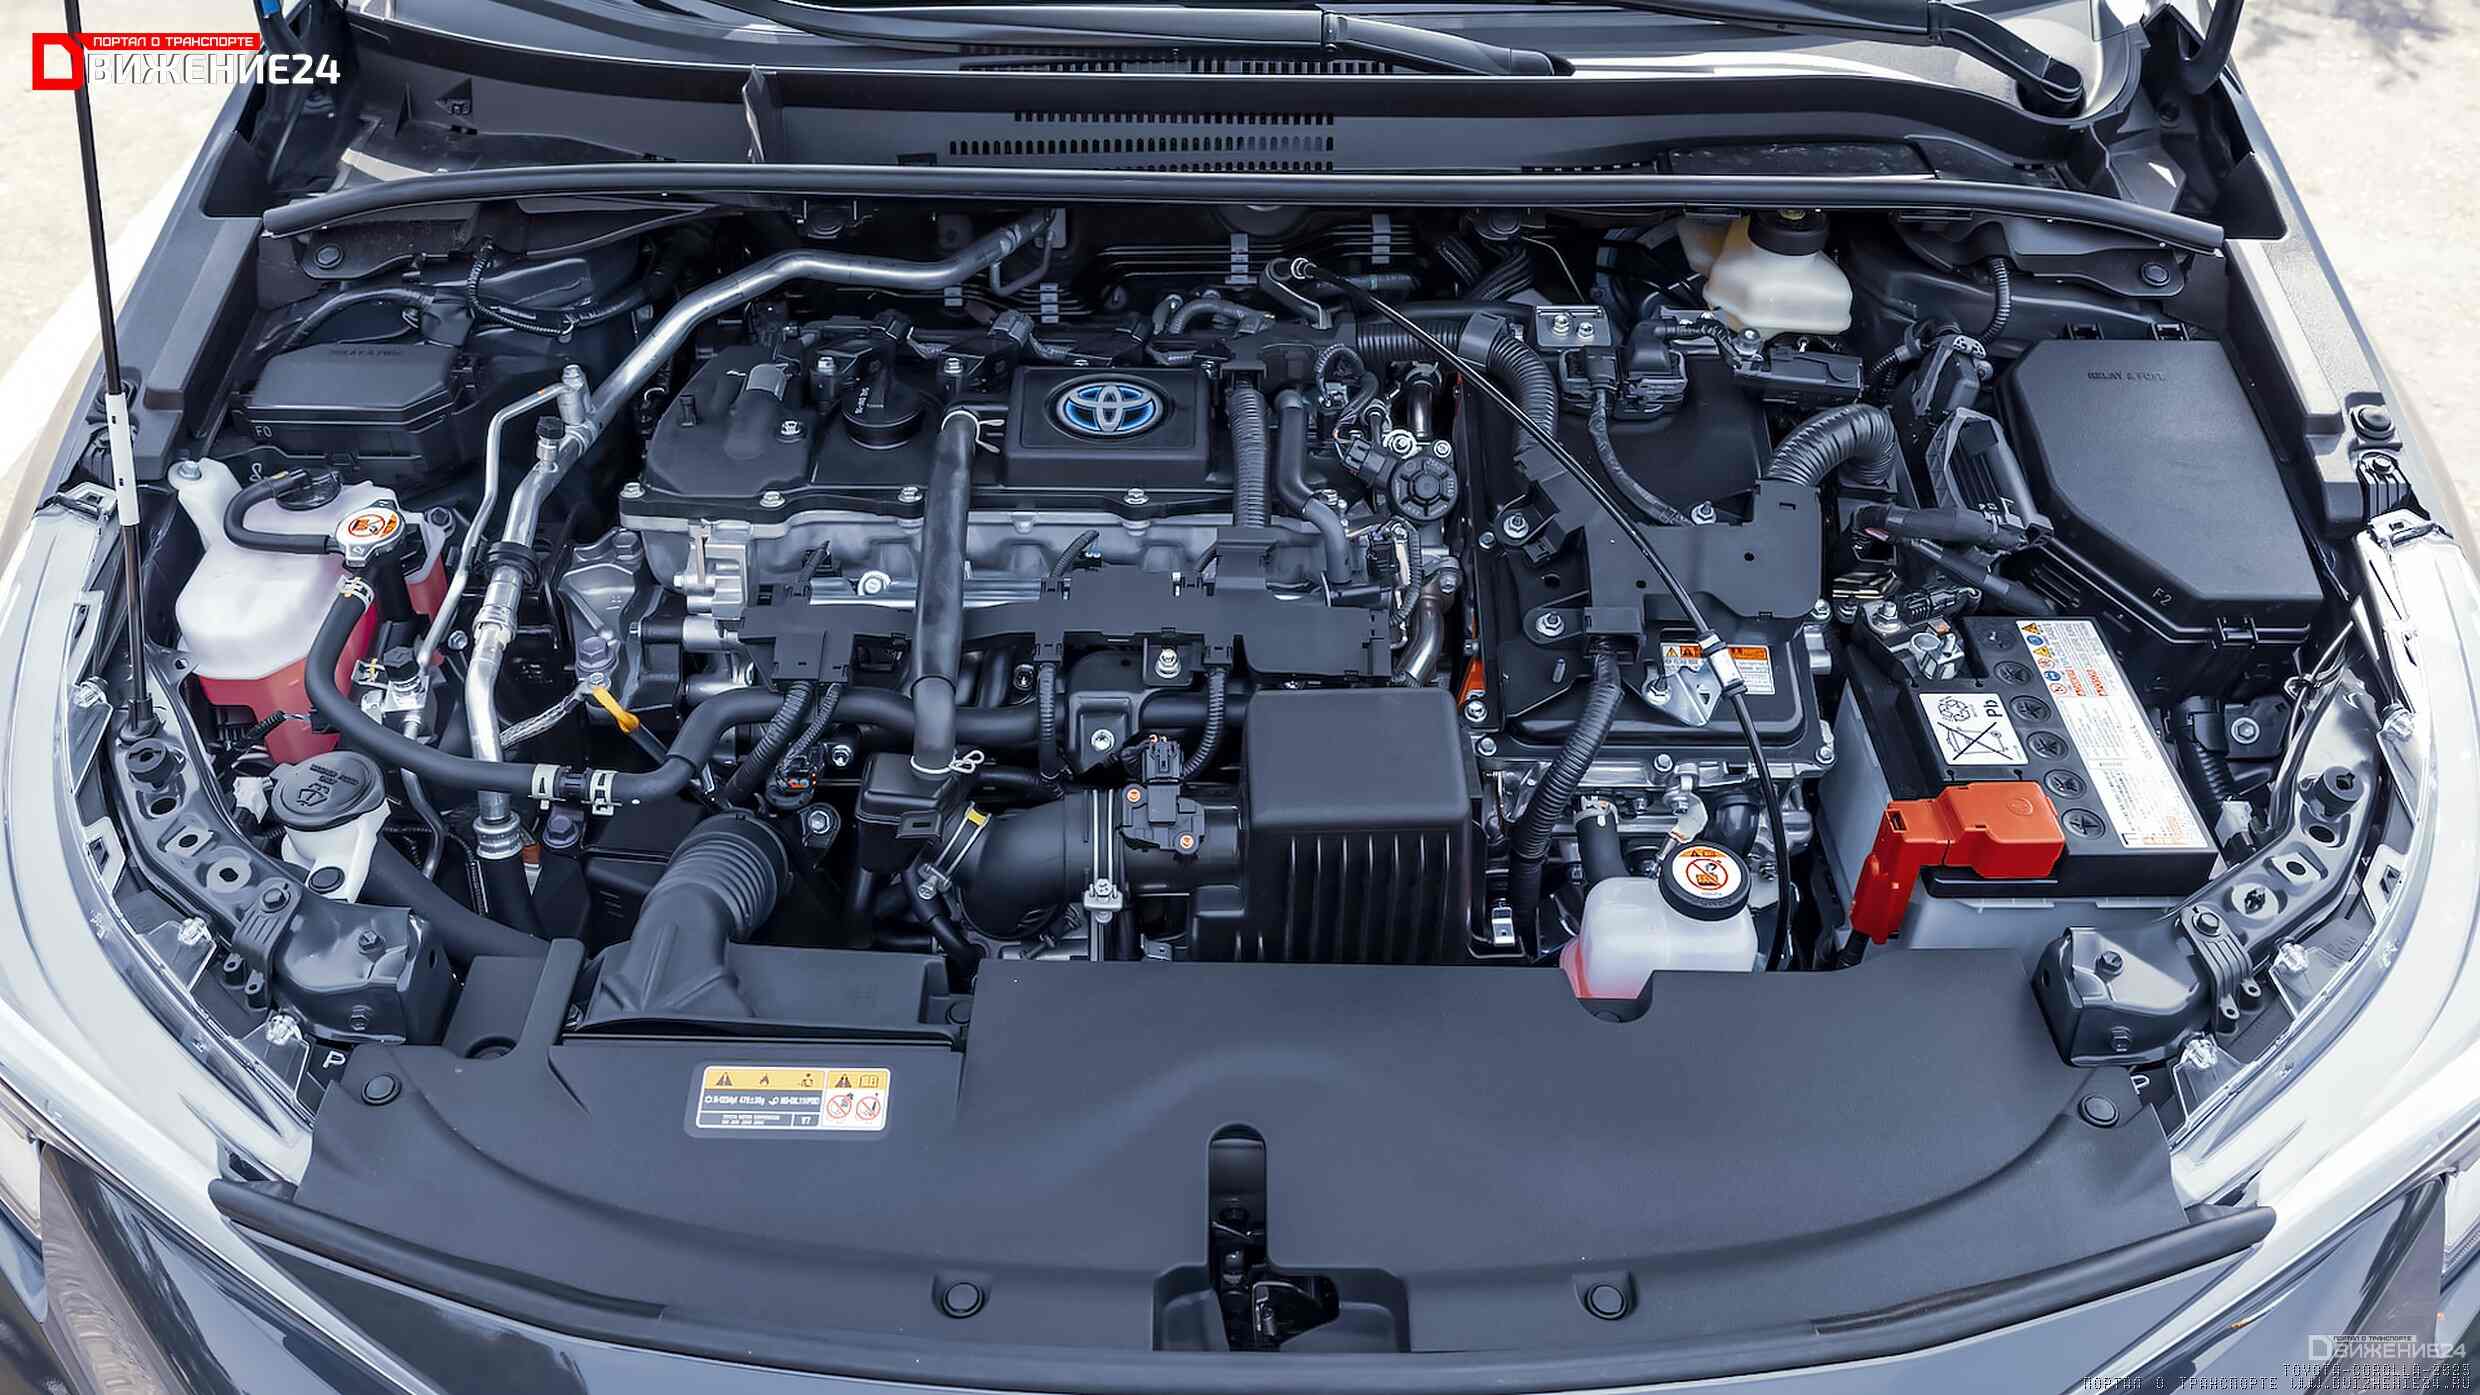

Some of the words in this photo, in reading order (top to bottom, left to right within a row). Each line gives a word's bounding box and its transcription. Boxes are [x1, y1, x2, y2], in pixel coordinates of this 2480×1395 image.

[2151, 587, 2174, 607] F2
[1983, 699, 2003, 718] Pb
[322, 1049, 346, 1069] P
